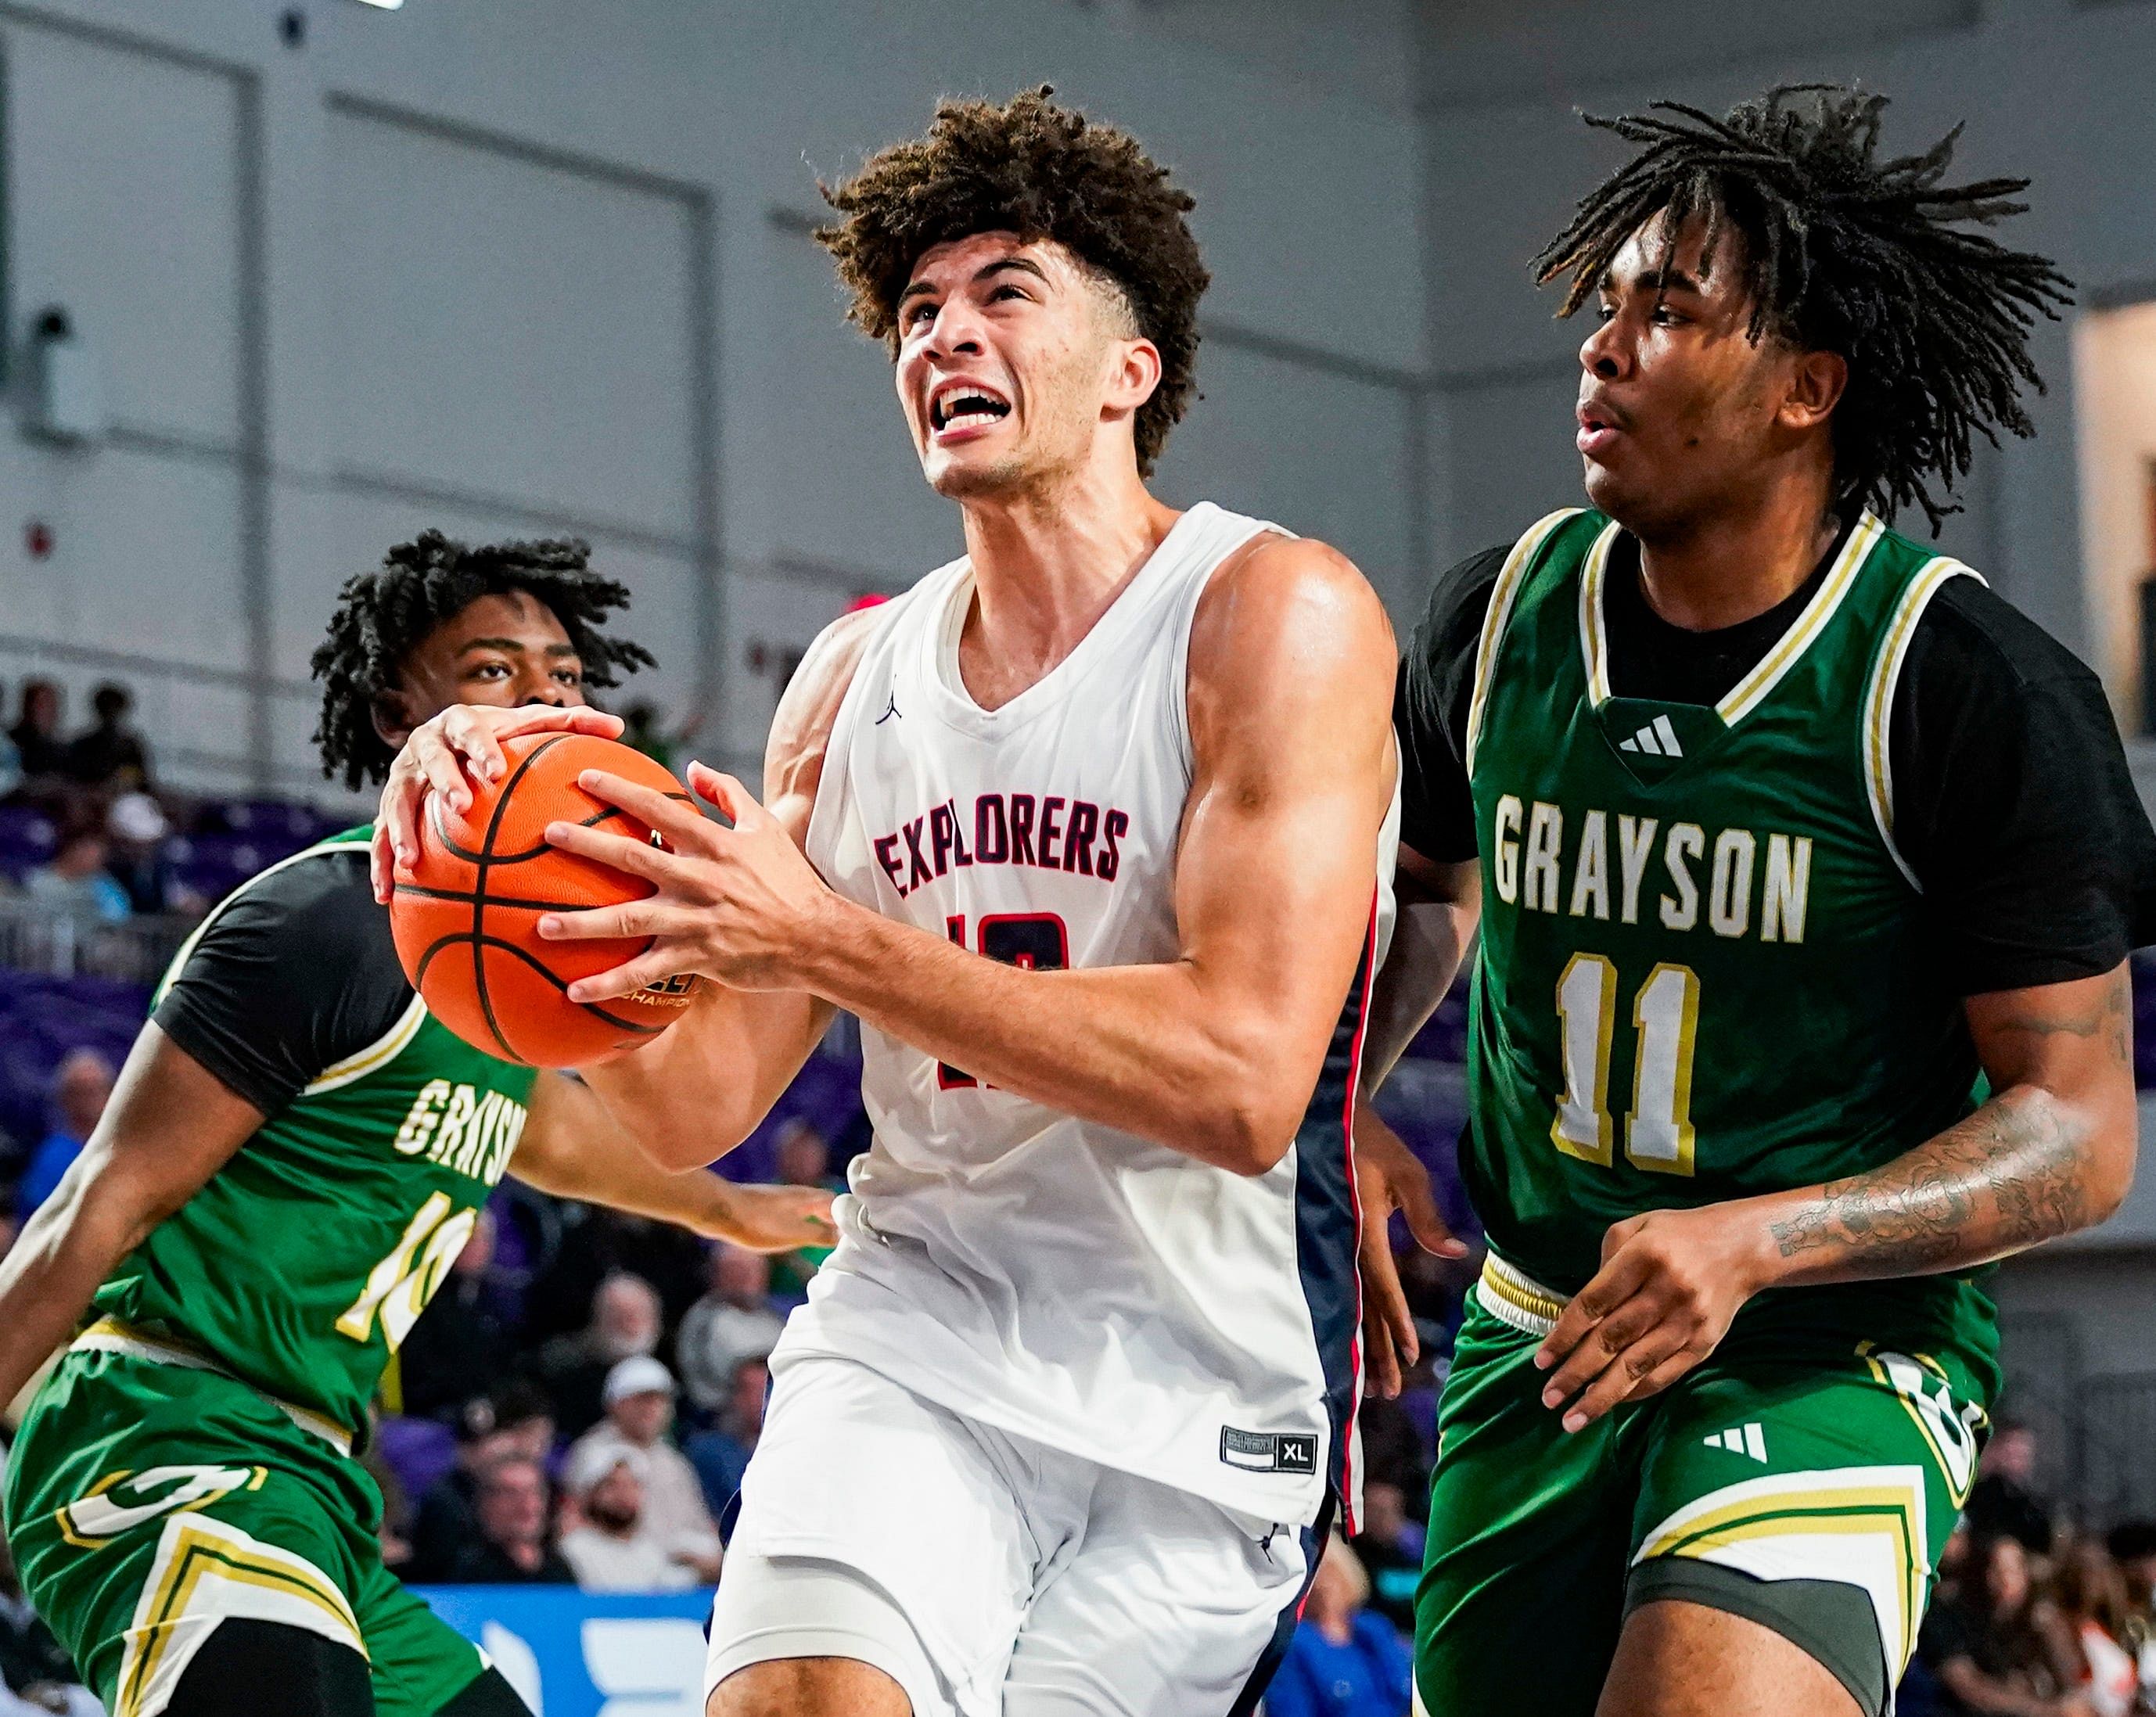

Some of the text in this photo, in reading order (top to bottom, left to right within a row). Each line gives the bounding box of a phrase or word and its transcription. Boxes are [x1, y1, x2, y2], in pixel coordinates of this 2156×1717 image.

[873, 792, 1130, 900] EXPLORERS
[1494, 793, 1813, 944] GRAYSON
[1549, 951, 1701, 1178] 11
[1283, 1442, 1309, 1462] XL
